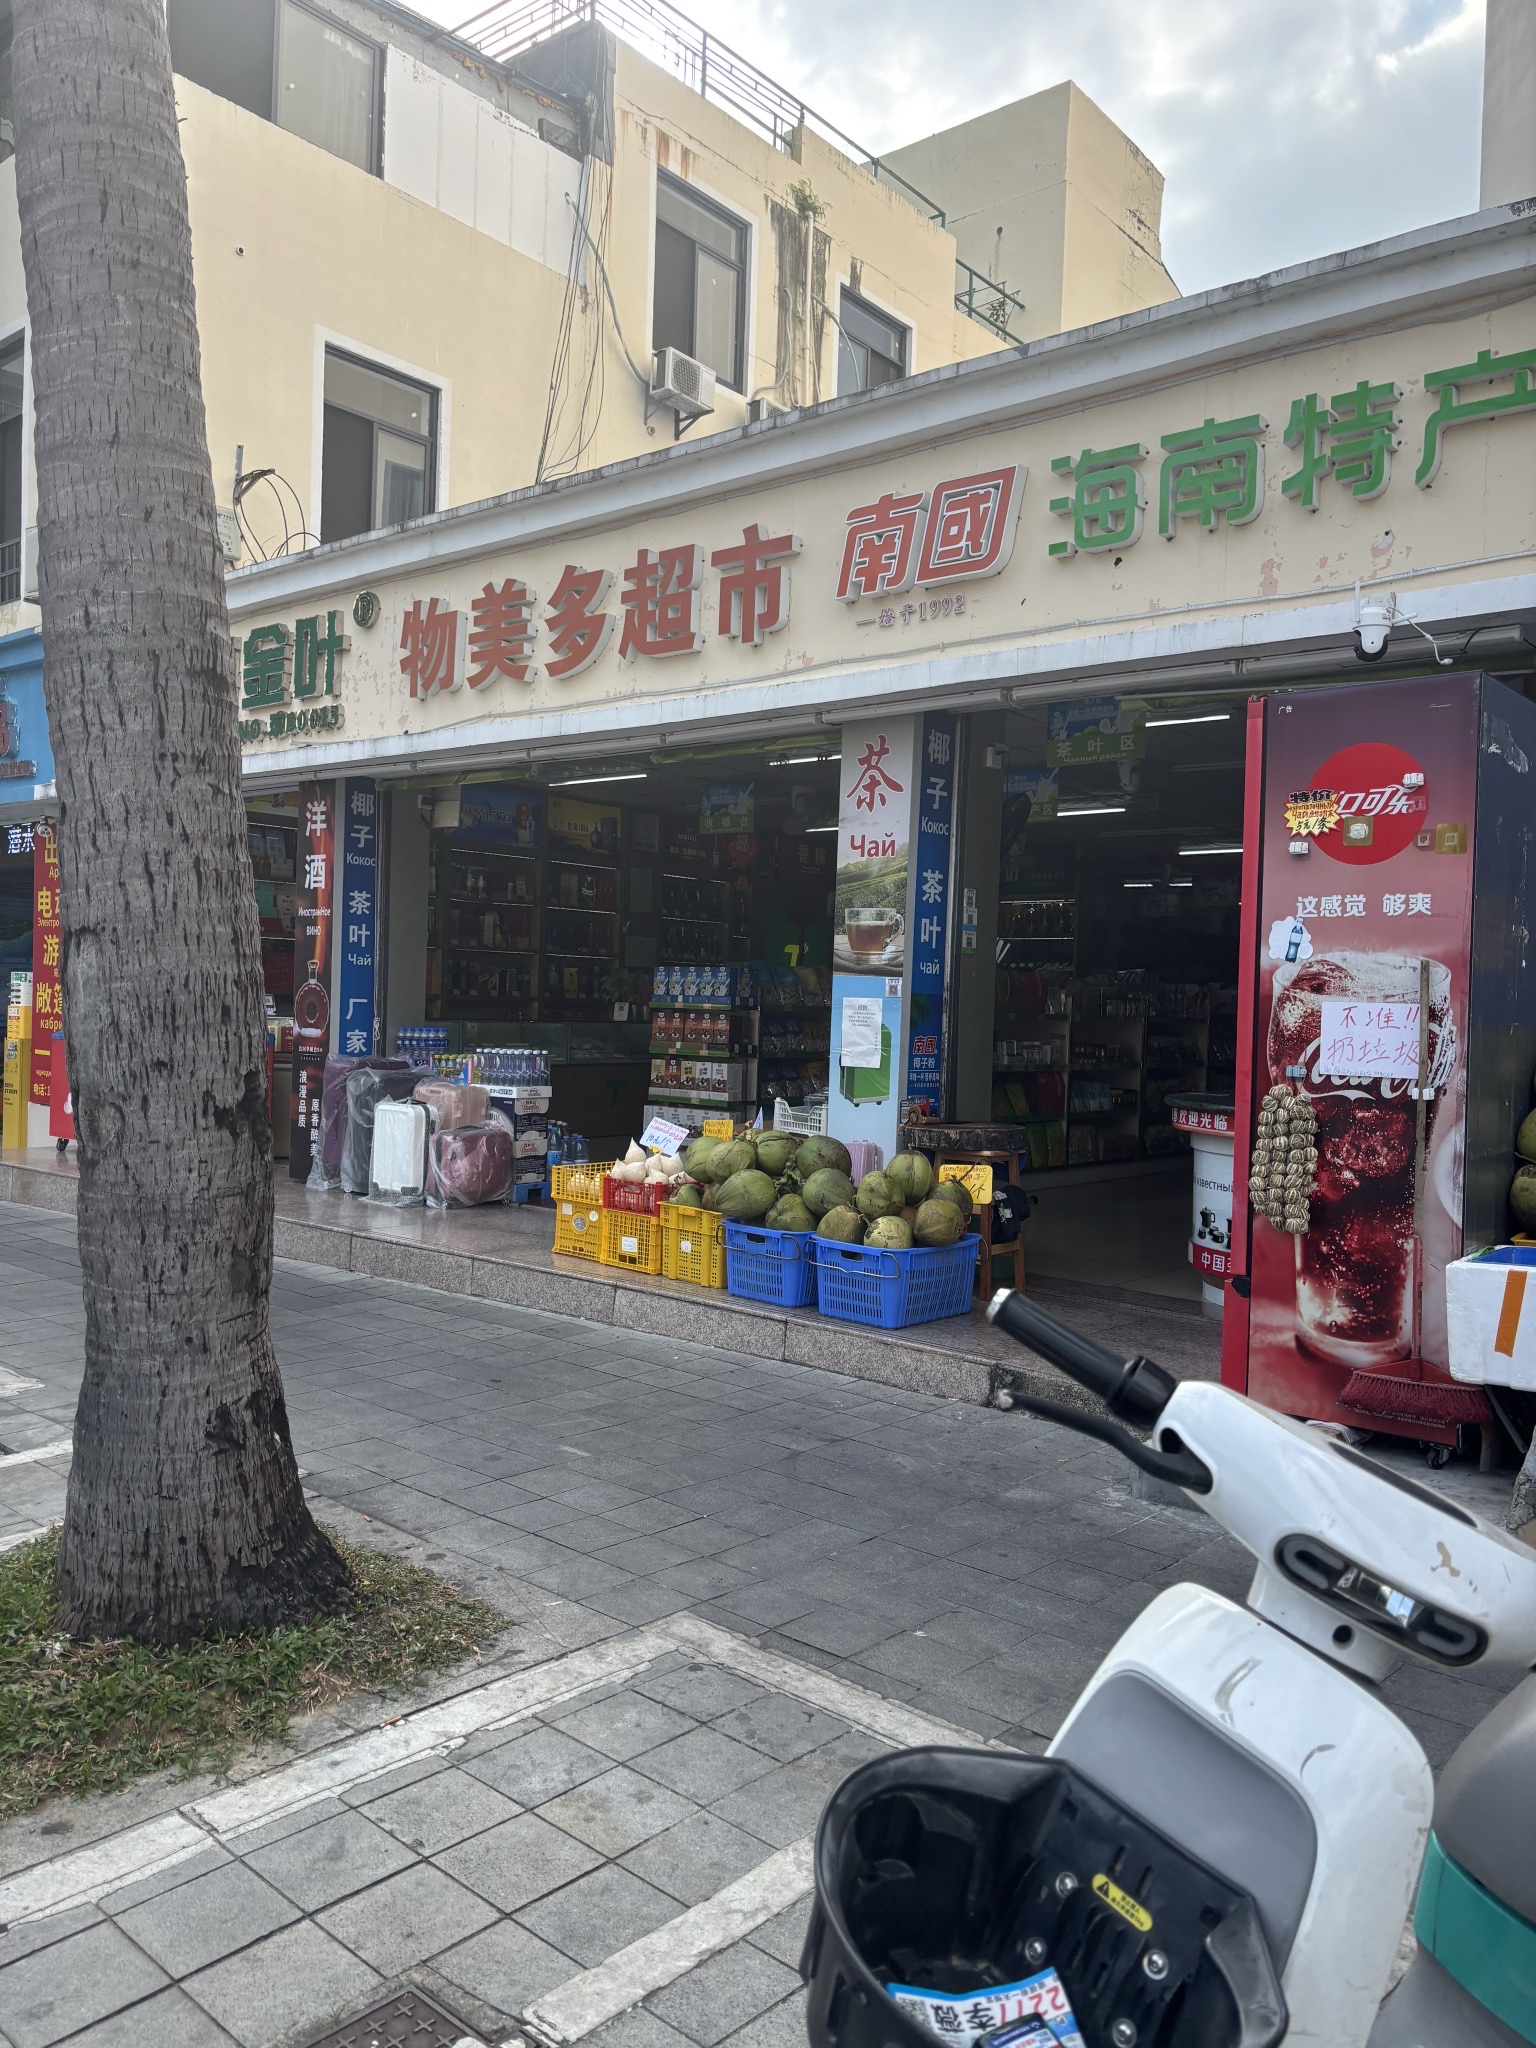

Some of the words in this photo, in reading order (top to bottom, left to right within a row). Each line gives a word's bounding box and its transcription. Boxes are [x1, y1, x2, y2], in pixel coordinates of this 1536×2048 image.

[1048, 349, 1536, 559] 海南特产
[835, 465, 1027, 603] 南國
[400, 523, 803, 702] 物美多超市
[241, 609, 352, 711] 金叶
[846, 733, 905, 814] 茶
[926, 728, 951, 810] 椰子
[1056, 735, 1136, 759] 茶叶区
[350, 791, 375, 849] 椰子
[1289, 789, 1334, 804] 特价
[1335, 784, 1415, 819] 口可乐
[304, 801, 328, 891] 洋酒
[849, 832, 896, 858] Чай
[921, 816, 949, 836] Кокос
[346, 852, 376, 867] Кокос
[348, 890, 372, 948] 茶叶
[920, 868, 944, 950] 茶叶
[1296, 894, 1367, 918] 这感觉
[1382, 892, 1433, 917] 够爽
[345, 997, 369, 1055] 厂家
